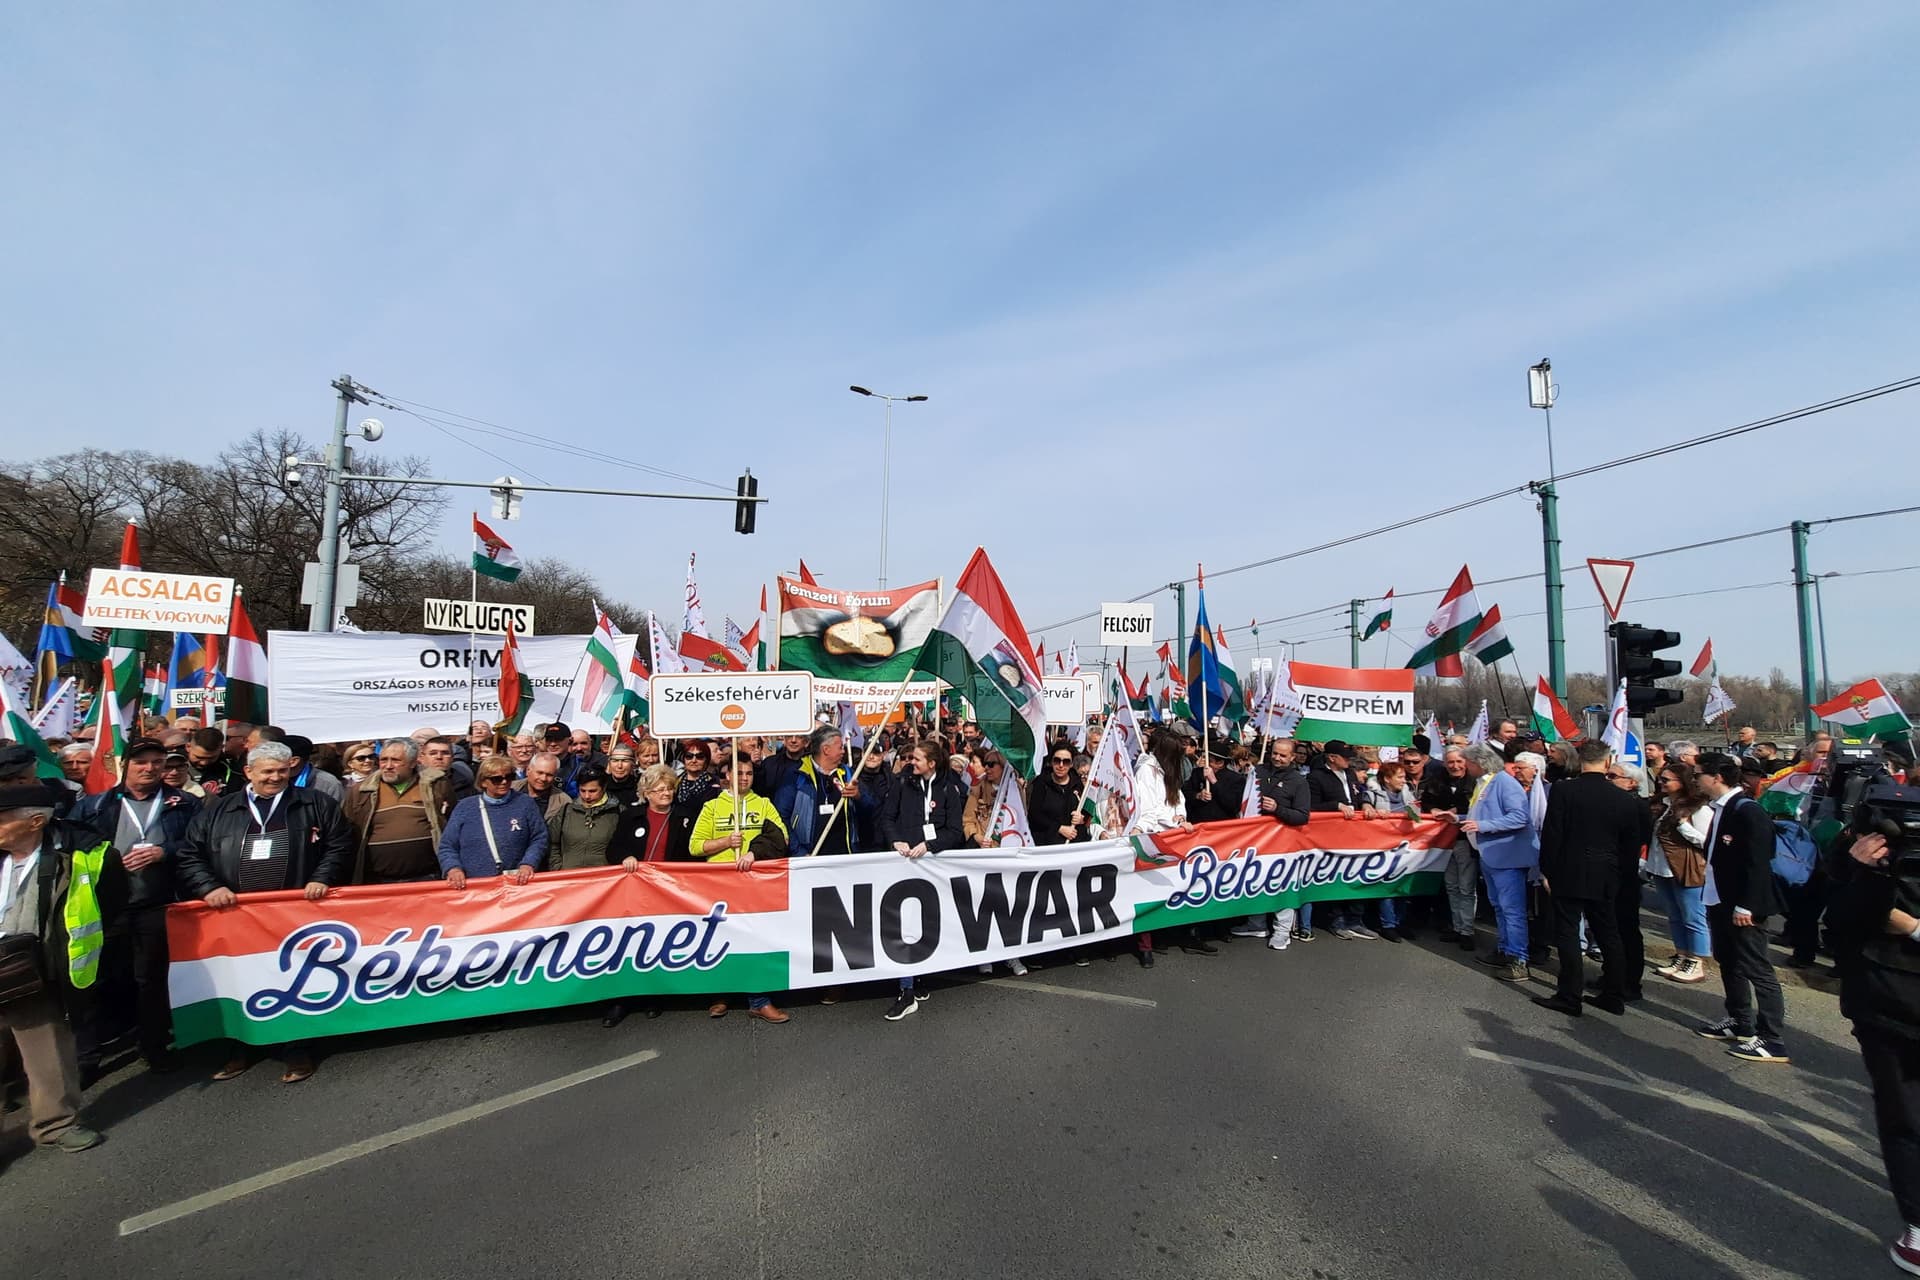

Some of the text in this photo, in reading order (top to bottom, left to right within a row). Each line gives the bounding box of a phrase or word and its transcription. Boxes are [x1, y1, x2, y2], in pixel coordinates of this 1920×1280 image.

[101, 575, 222, 602] ACSALAG
[87, 606, 228, 625] VELETEK VAGYUNK
[426, 600, 527, 633] NYÍRLUGOS
[1103, 613, 1152, 633] FELCSÚT
[352, 678, 425, 690] ORSZÁGOS
[428, 679, 467, 689] ROMA
[813, 683, 938, 697] szállási Szerezete
[664, 686, 800, 702] Székesfehérvár
[407, 700, 499, 713] MISSZIÓ EGYES
[855, 700, 900, 717] FIDESZ
[721, 713, 745, 721] FIDESZ
[1167, 842, 1409, 906] Békemenet
[811, 863, 1121, 974] NO WAR
[245, 902, 728, 1019] Békemenet
